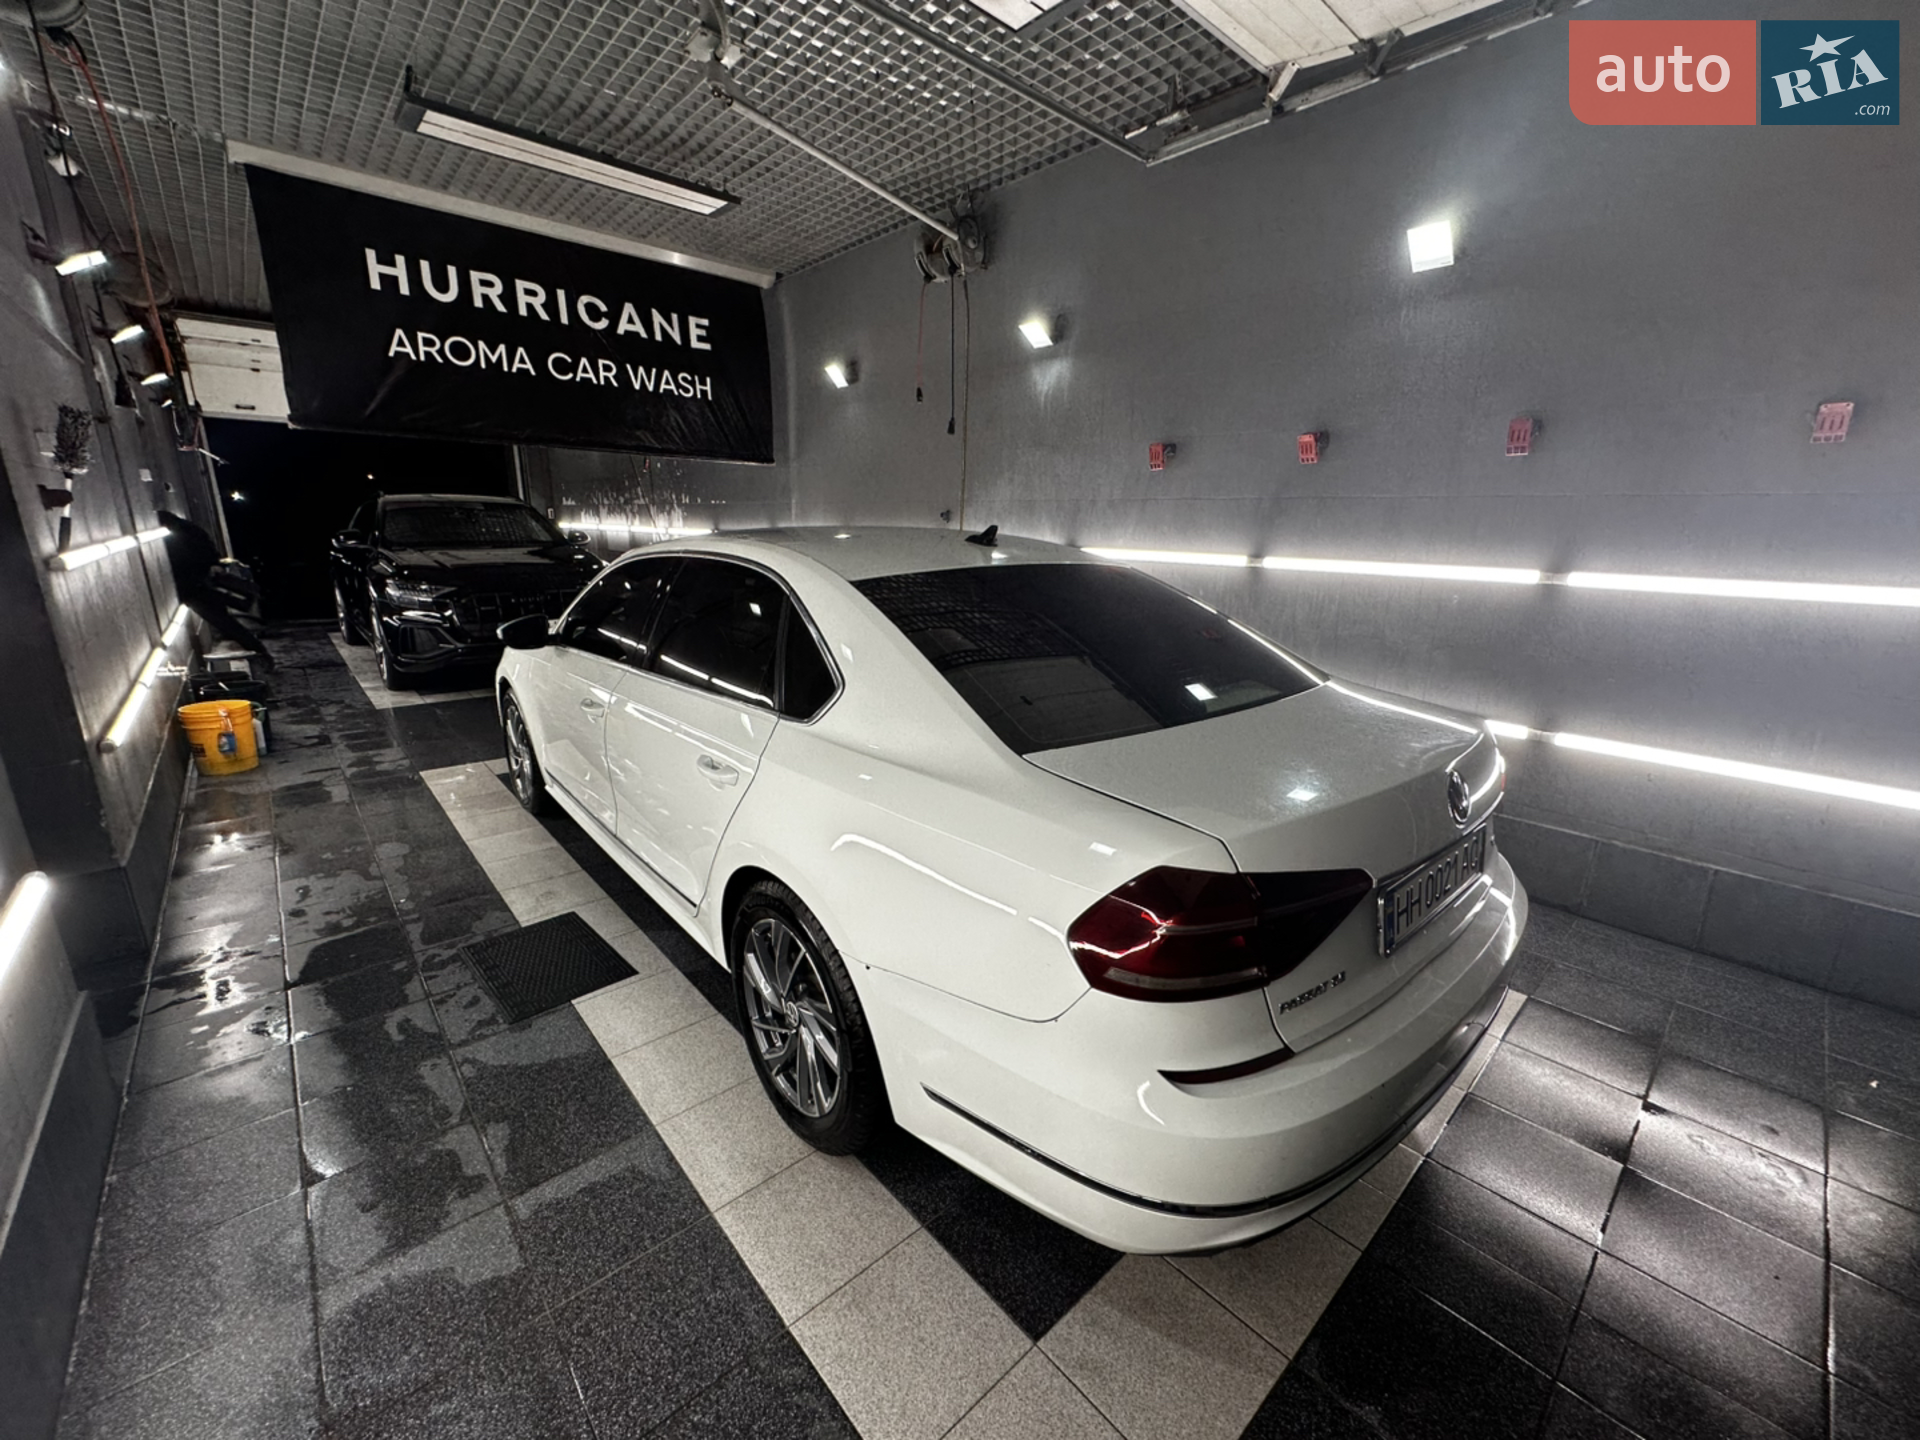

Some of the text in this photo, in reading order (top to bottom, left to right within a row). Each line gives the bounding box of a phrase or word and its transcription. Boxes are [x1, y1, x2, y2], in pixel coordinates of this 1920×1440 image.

[365, 247, 712, 351] HURRICANE
[388, 328, 713, 401] AROMA CAR WASH
